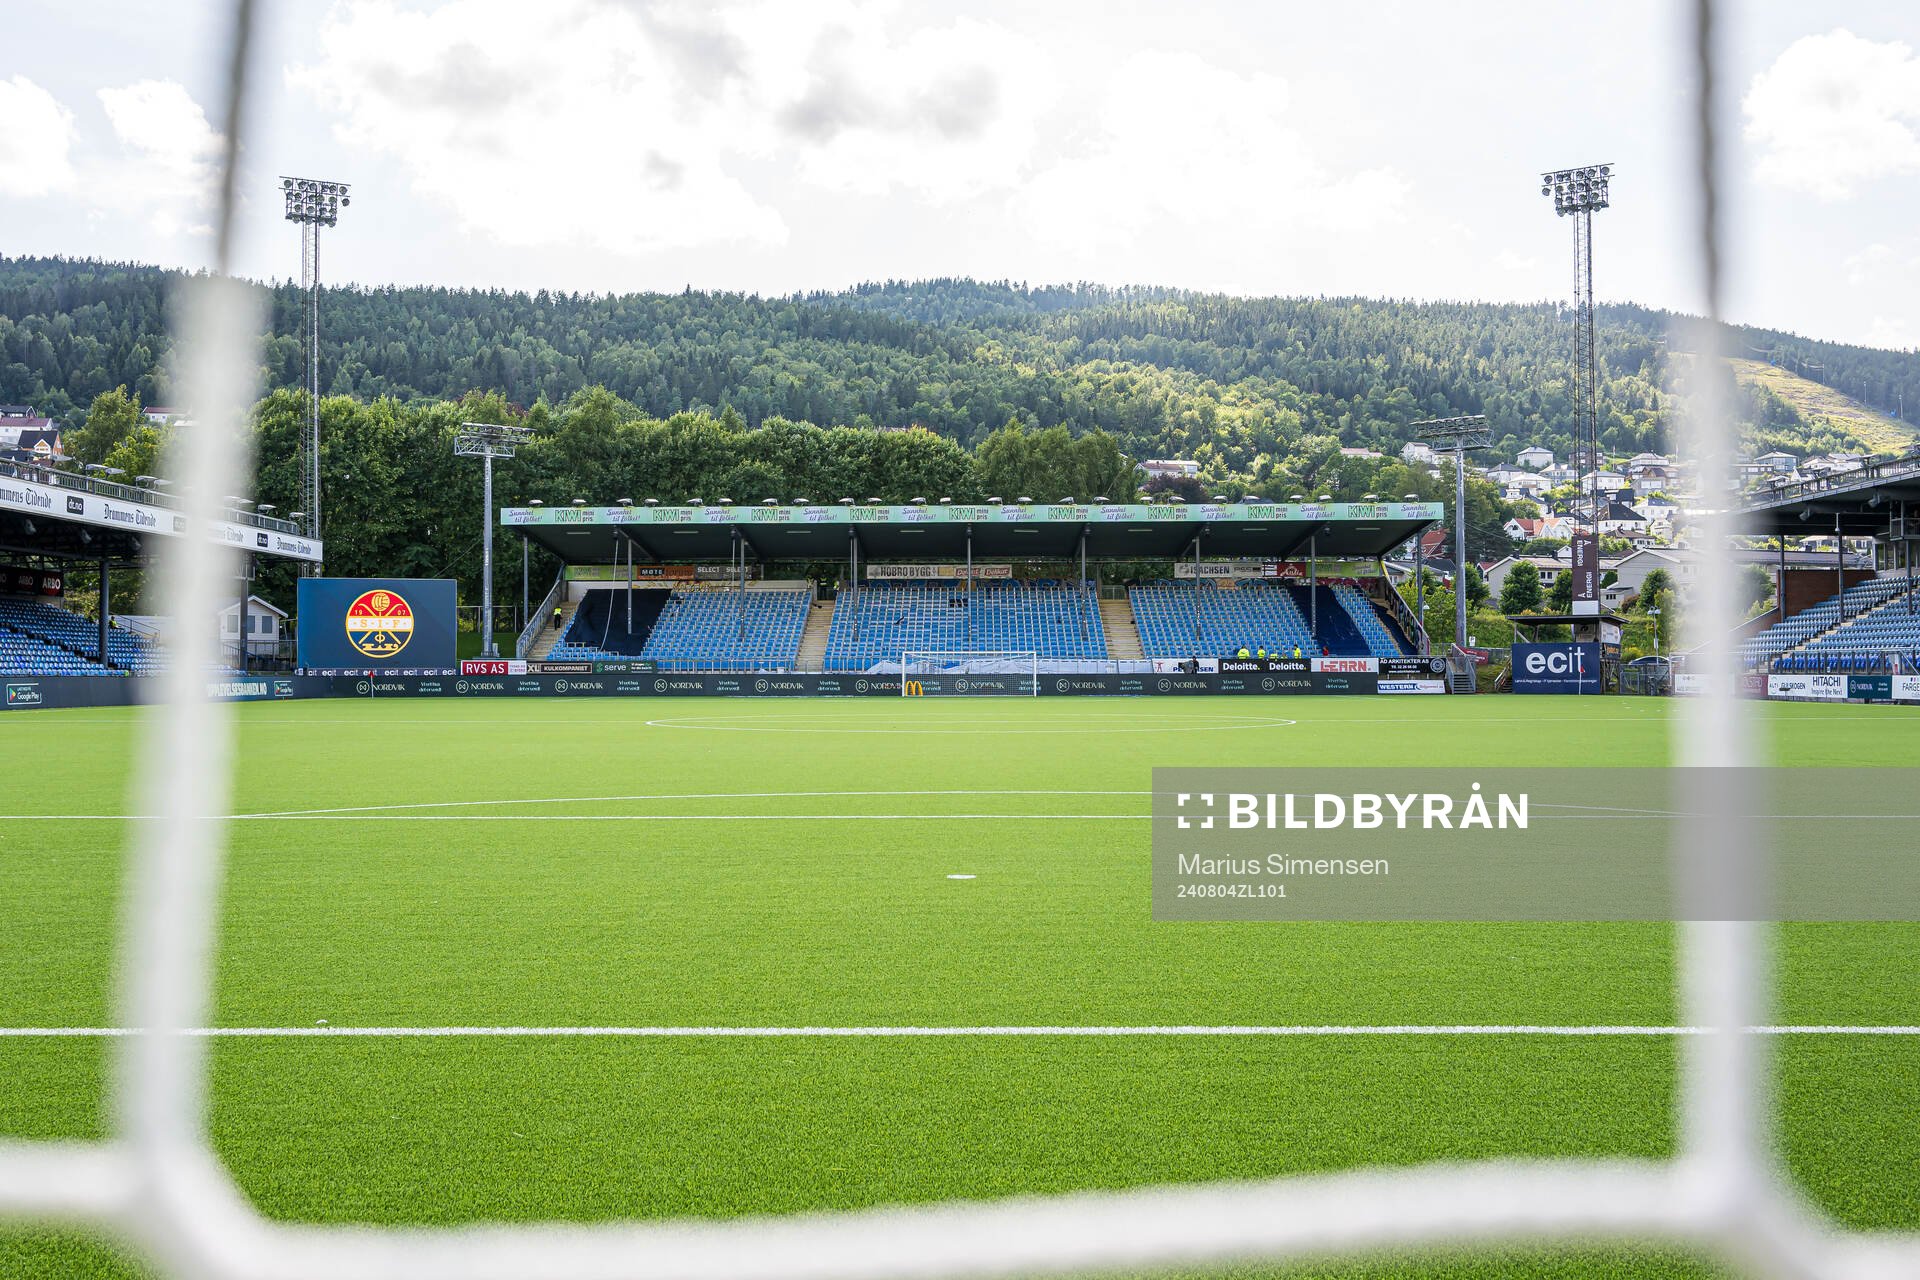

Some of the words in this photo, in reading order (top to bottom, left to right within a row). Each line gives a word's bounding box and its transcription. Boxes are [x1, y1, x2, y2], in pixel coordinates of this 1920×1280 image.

[555, 510, 581, 522] KIWI
[653, 510, 679, 521] KIWI
[751, 509, 777, 520] KIWI
[850, 508, 876, 520] KIWI
[949, 508, 976, 520] KIWI
[1048, 507, 1075, 520] KIWI
[1148, 506, 1174, 519] KIWI
[1248, 506, 1275, 518] KIWI
[1348, 505, 1375, 518] KIWI
[910, 567, 931, 576] BYGG
[42, 577, 61, 590] ARBO
[1525, 646, 1585, 673] ecit
[466, 663, 487, 673] RVS
[490, 663, 505, 673] AS
[528, 663, 540, 672] XL
[1072, 681, 1106, 689] NORDVIK
[1173, 681, 1207, 689] NORDVIK
[1277, 680, 1311, 688] NORDVIK
[1812, 676, 1841, 687] HITACHI
